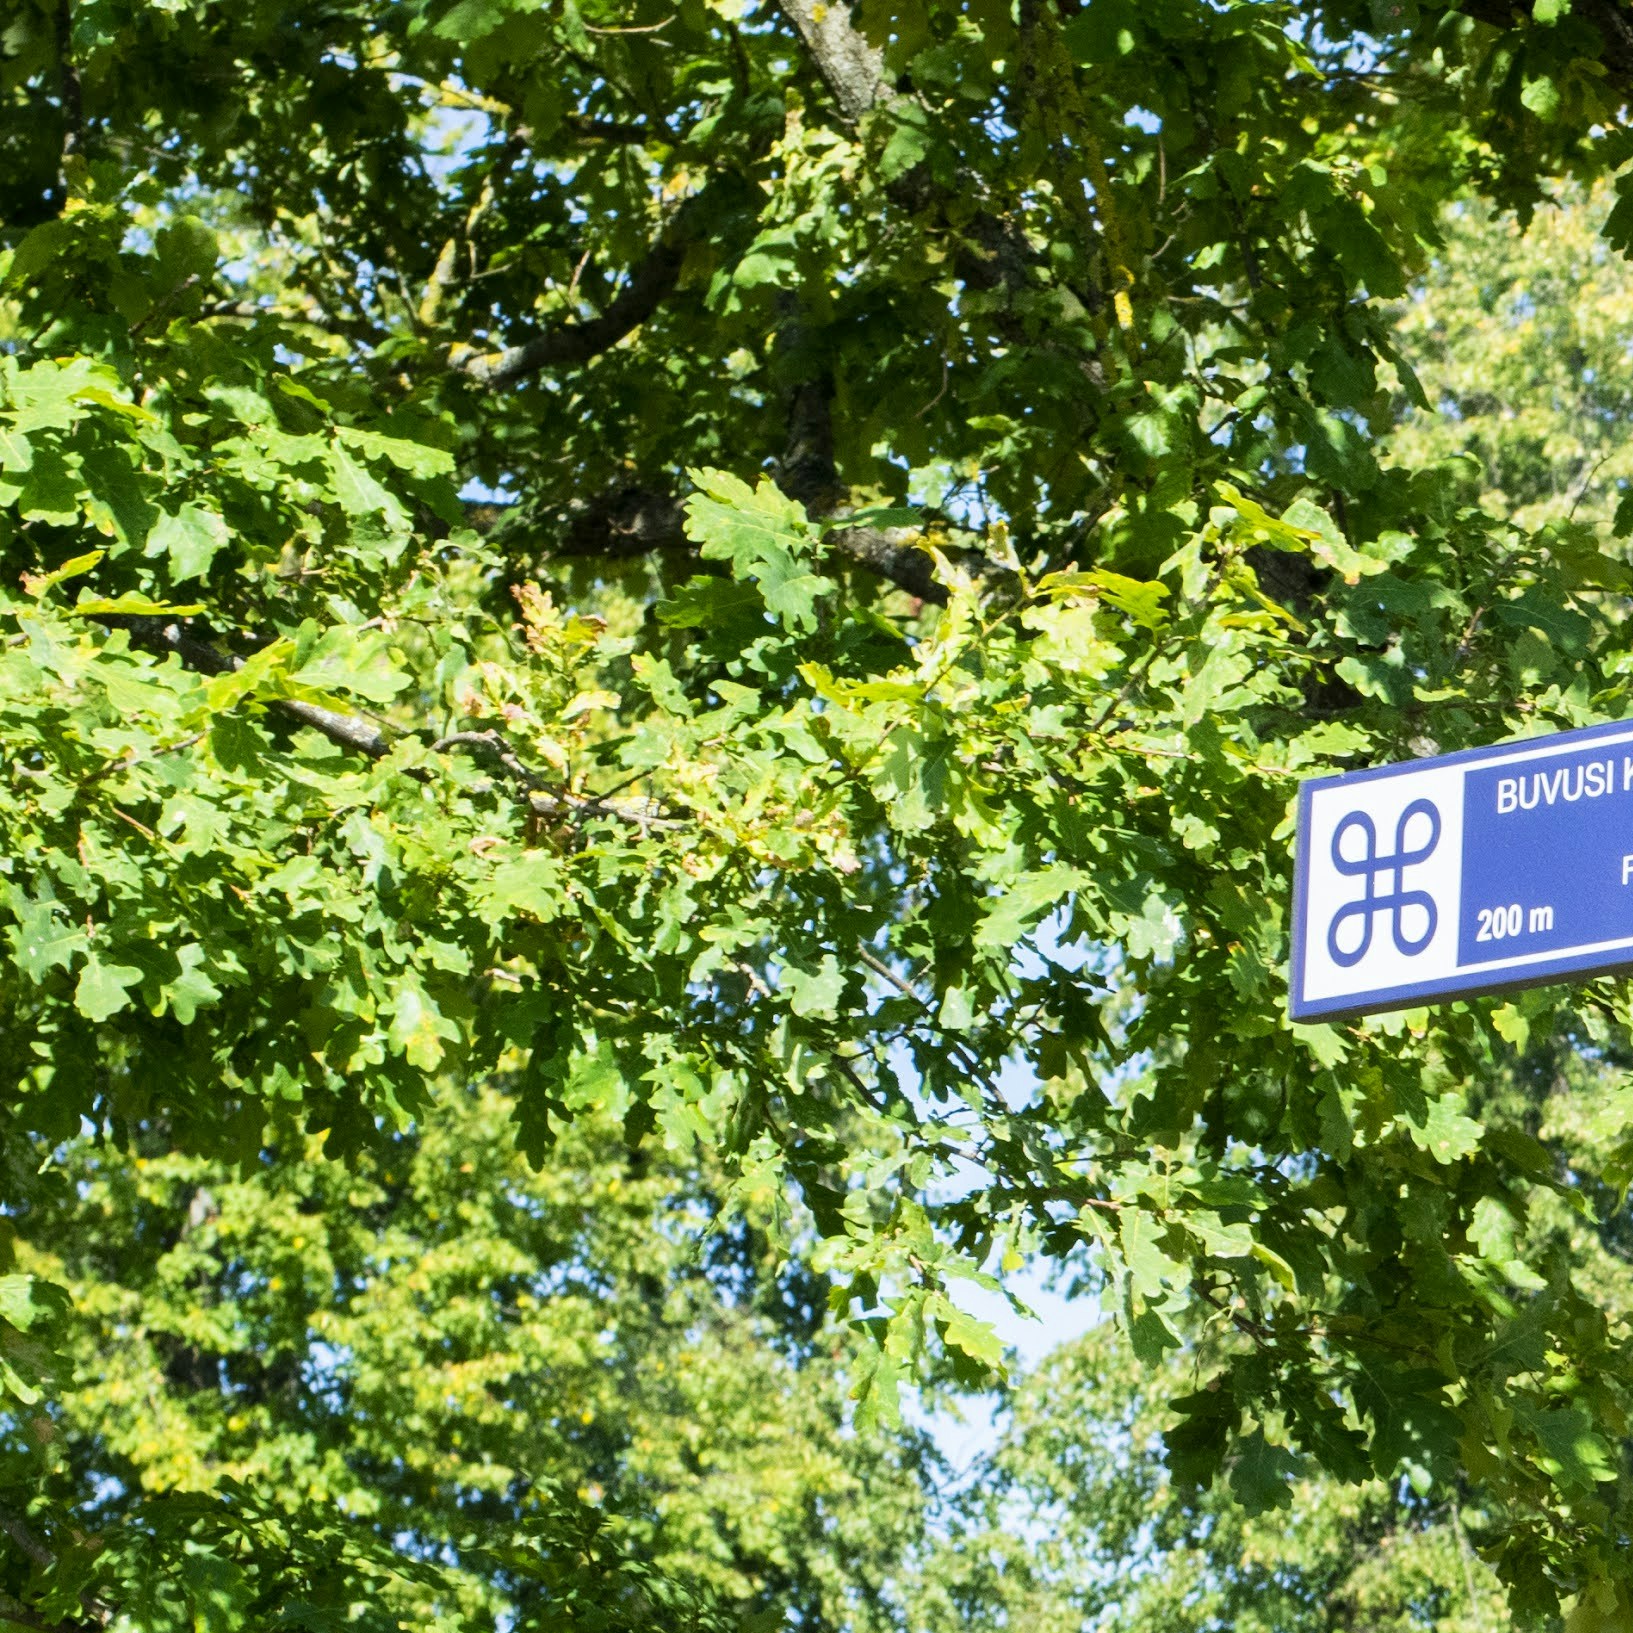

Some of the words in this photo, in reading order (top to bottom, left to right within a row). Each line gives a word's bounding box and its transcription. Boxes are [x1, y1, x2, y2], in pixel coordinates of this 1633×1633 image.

[1497, 759, 1614, 814] BUVUSI
[1476, 903, 1523, 942] 200
[1528, 905, 1554, 933] m
